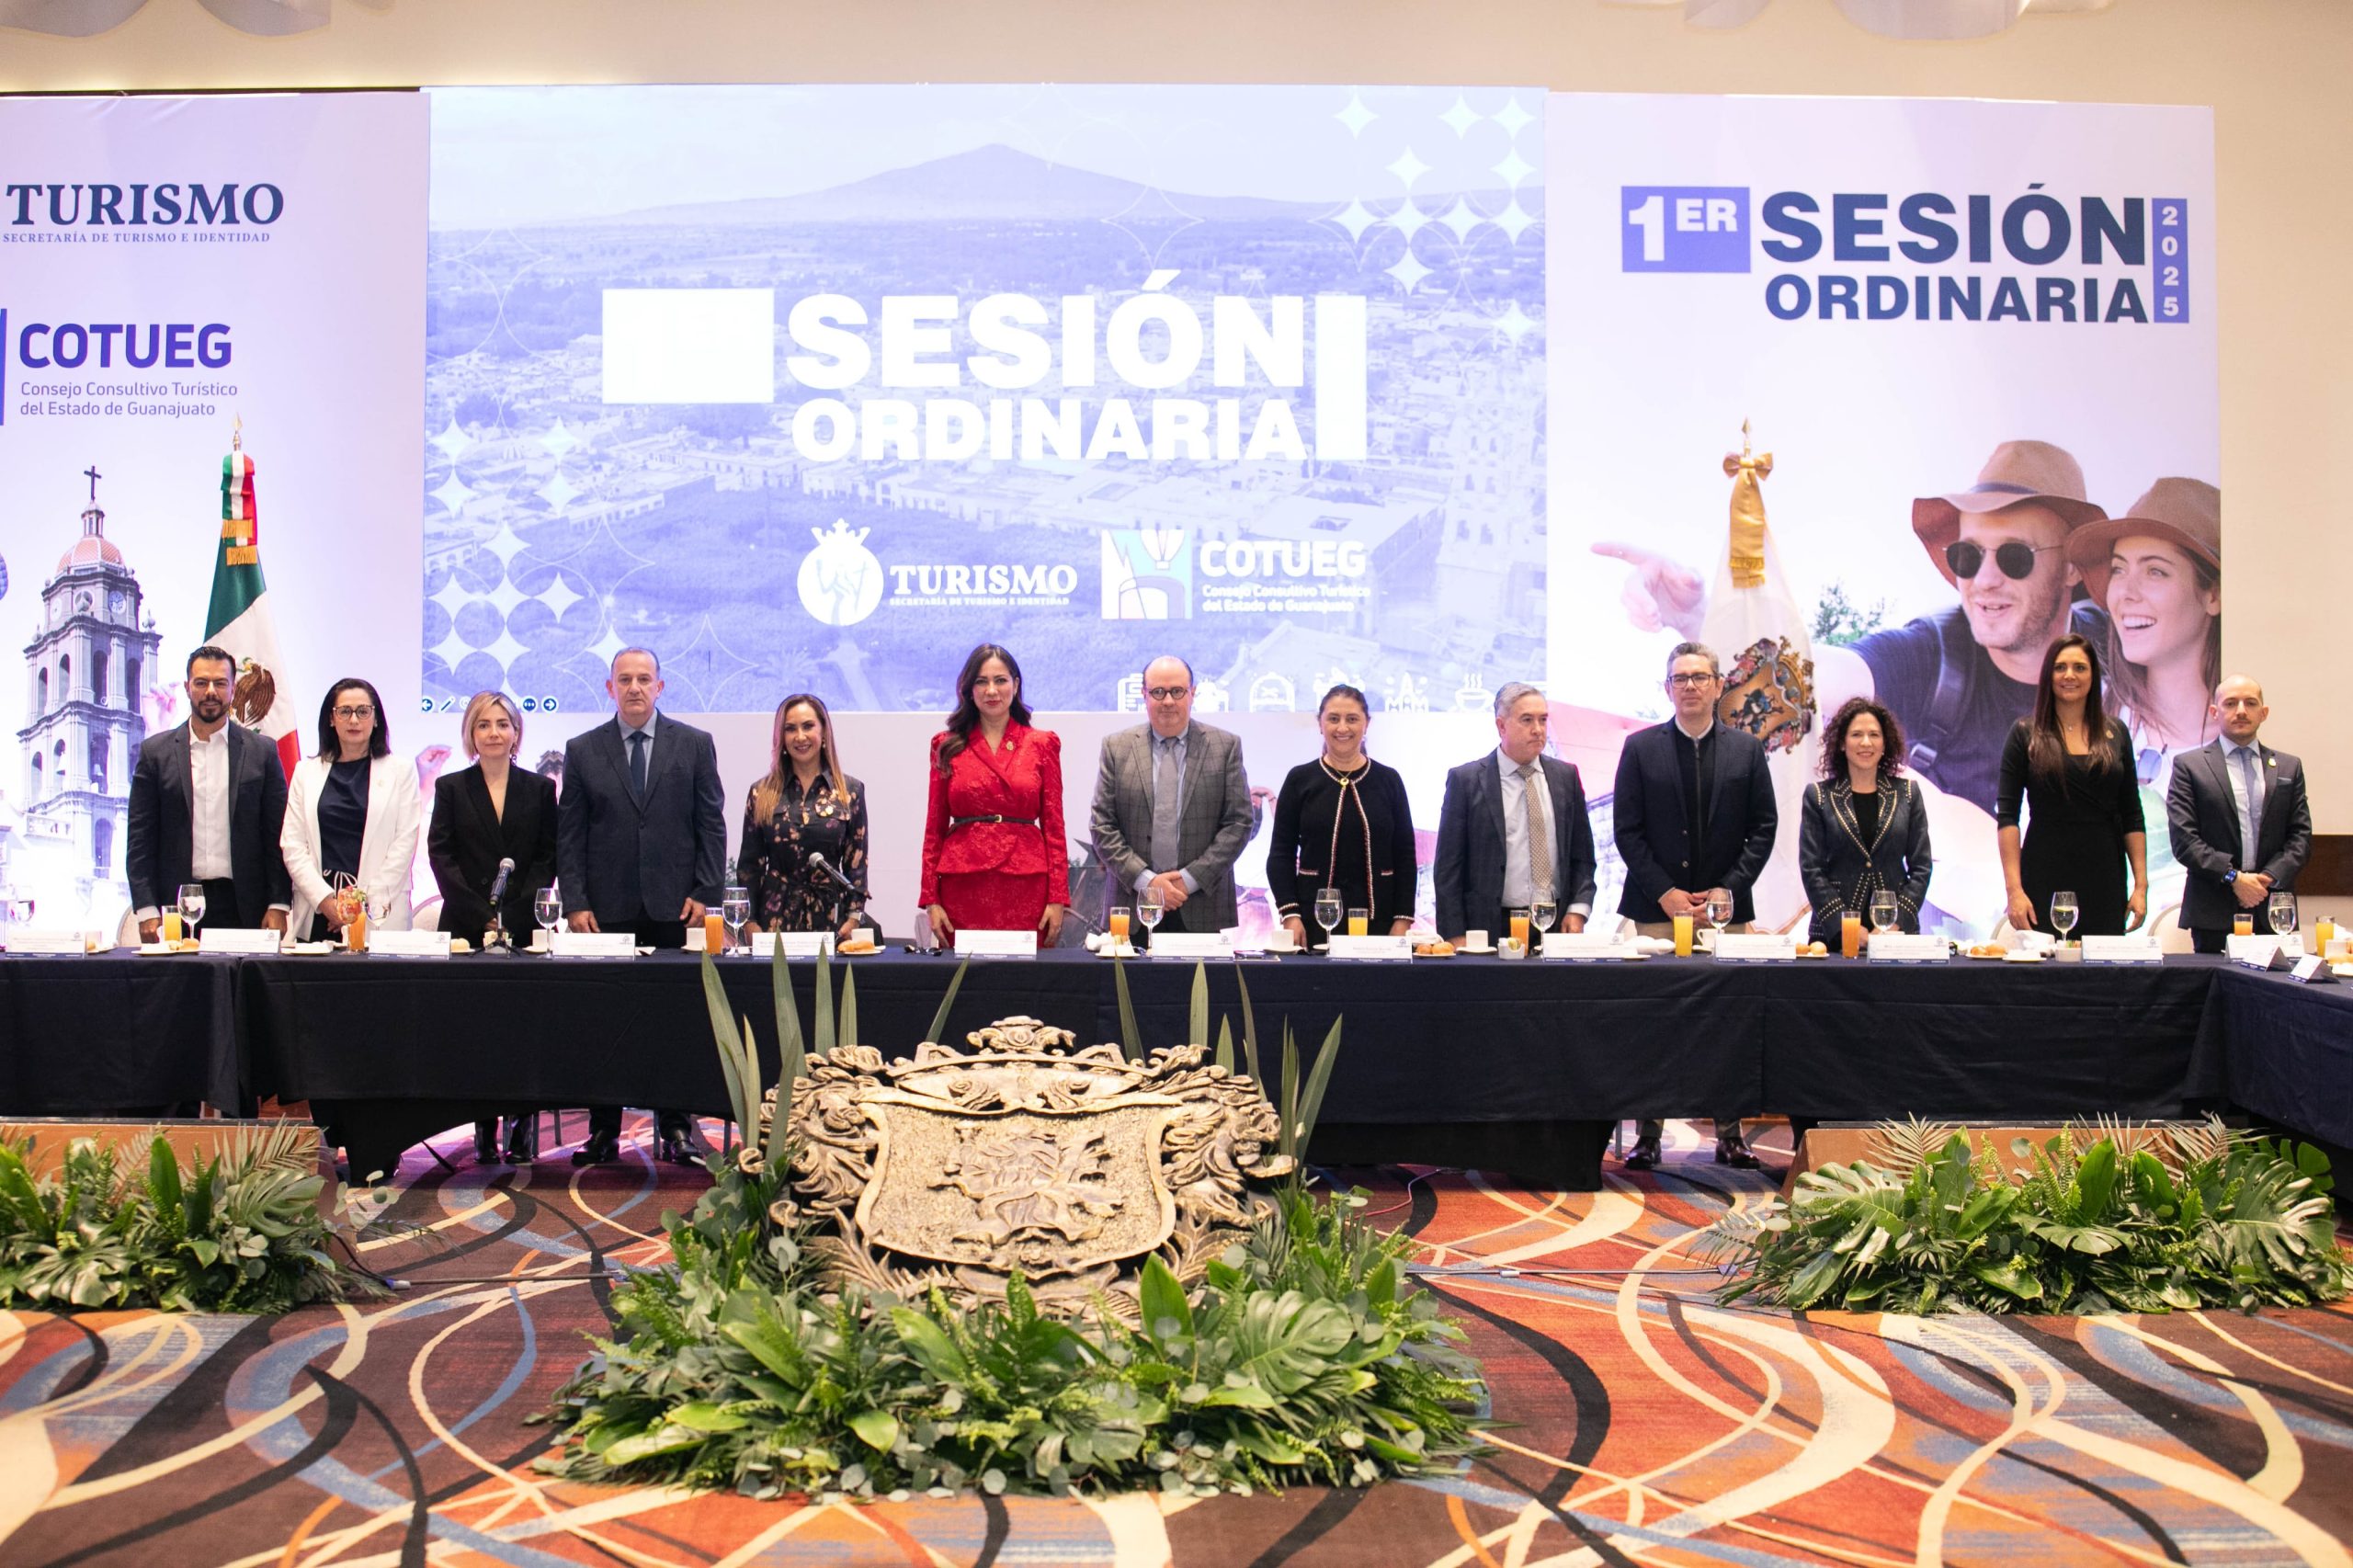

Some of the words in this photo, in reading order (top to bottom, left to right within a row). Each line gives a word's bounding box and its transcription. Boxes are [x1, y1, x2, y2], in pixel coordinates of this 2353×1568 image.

[6, 183, 284, 225] TURISMO
[3, 230, 86, 243] SECRETARÍA
[92, 233, 108, 243] DE
[114, 233, 176, 243] TURISMO
[181, 233, 189, 243] E
[194, 233, 270, 243] IDENTIDAD
[1760, 183, 2146, 266] SESIÓN
[1765, 273, 2150, 324] ORDINARIA
[19, 323, 233, 369] COTUEG
[786, 269, 1304, 389] SESIÓN
[21, 381, 82, 399] Consejo
[86, 381, 168, 396] Consultivo
[172, 381, 238, 396] Turístico
[20, 402, 44, 415] del
[49, 402, 100, 415] Estado
[105, 402, 123, 415] de
[128, 402, 215, 419] Guanajuato
[791, 397, 1308, 461] ORDINARIA
[1199, 540, 1367, 577] COTUEG
[890, 564, 1078, 595] TURISMO
[965, 597, 1007, 606] TURISMO
